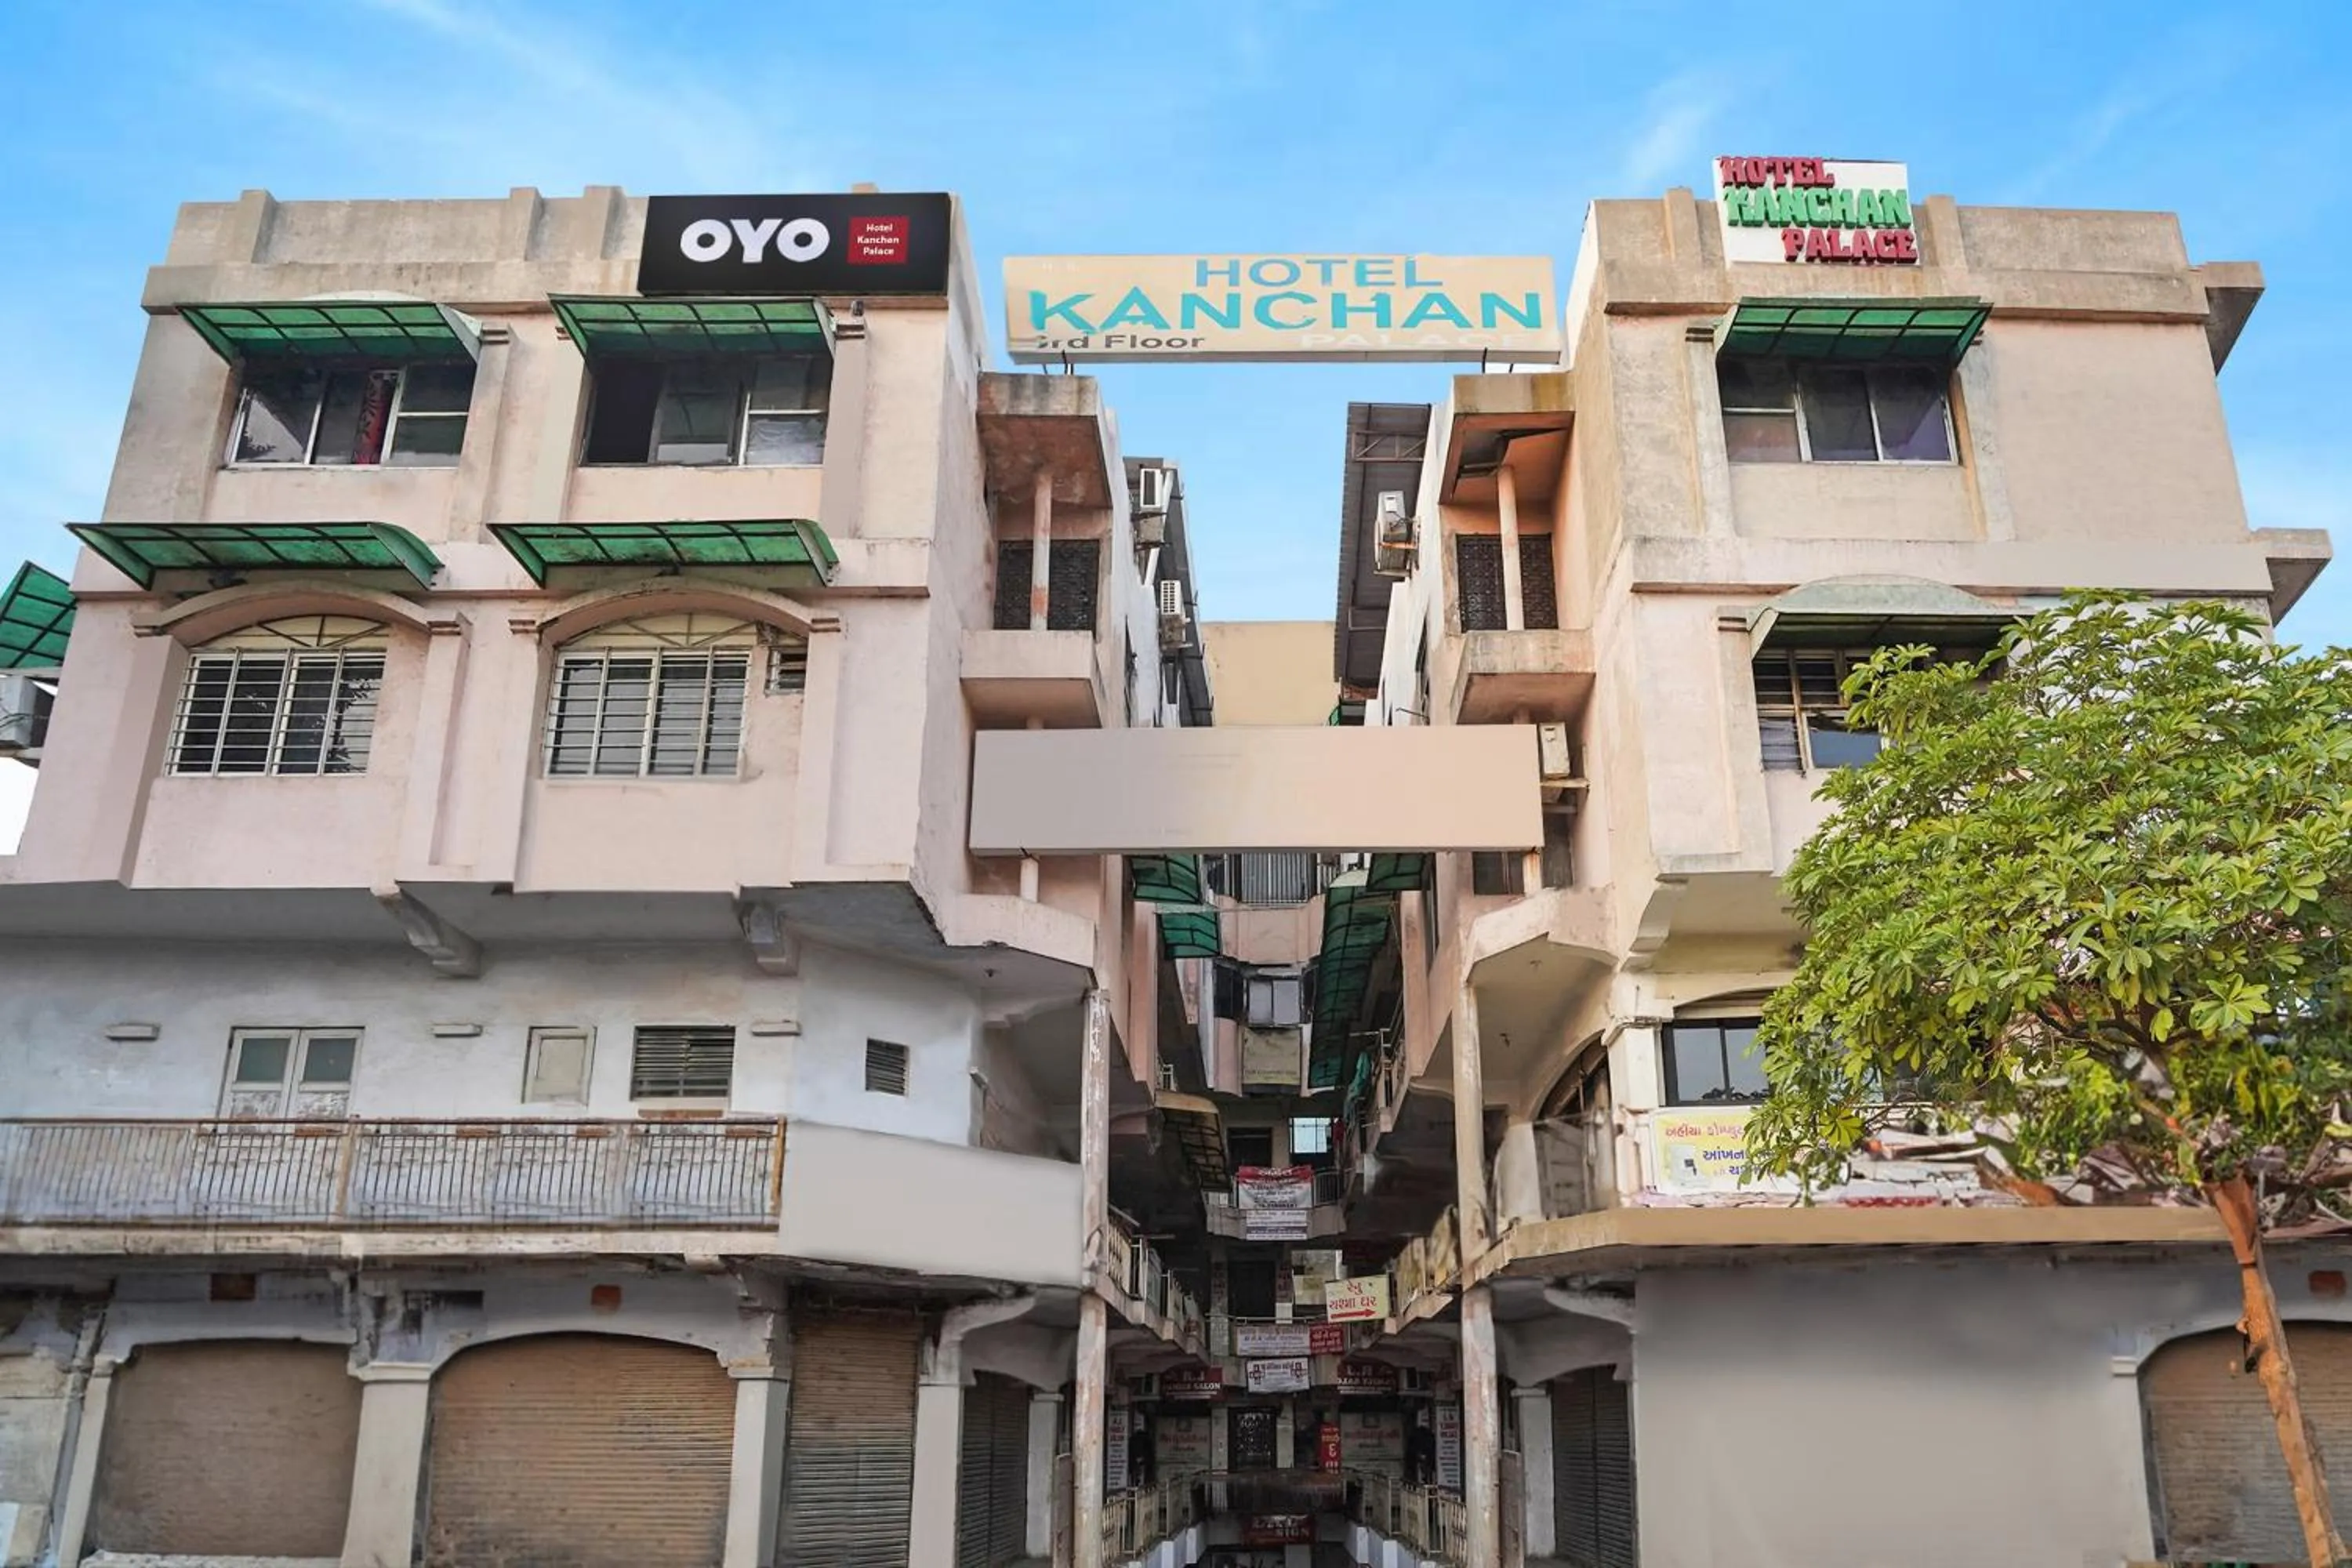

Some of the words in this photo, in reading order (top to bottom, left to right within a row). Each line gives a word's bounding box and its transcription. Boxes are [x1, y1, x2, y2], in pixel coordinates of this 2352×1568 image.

[1720, 156, 1835, 189] HOTEL
[1724, 186, 1911, 229] KANCHAN
[680, 217, 830, 263] OYO
[857, 234, 900, 244] Kanchan
[866, 223, 894, 233] Hotel
[863, 246, 895, 256] Palace
[1781, 228, 1918, 263] PALACE
[1196, 258, 1443, 287] HOTEL
[1028, 285, 1542, 334] KANCHAN
[1105, 333, 1206, 349] Floor
